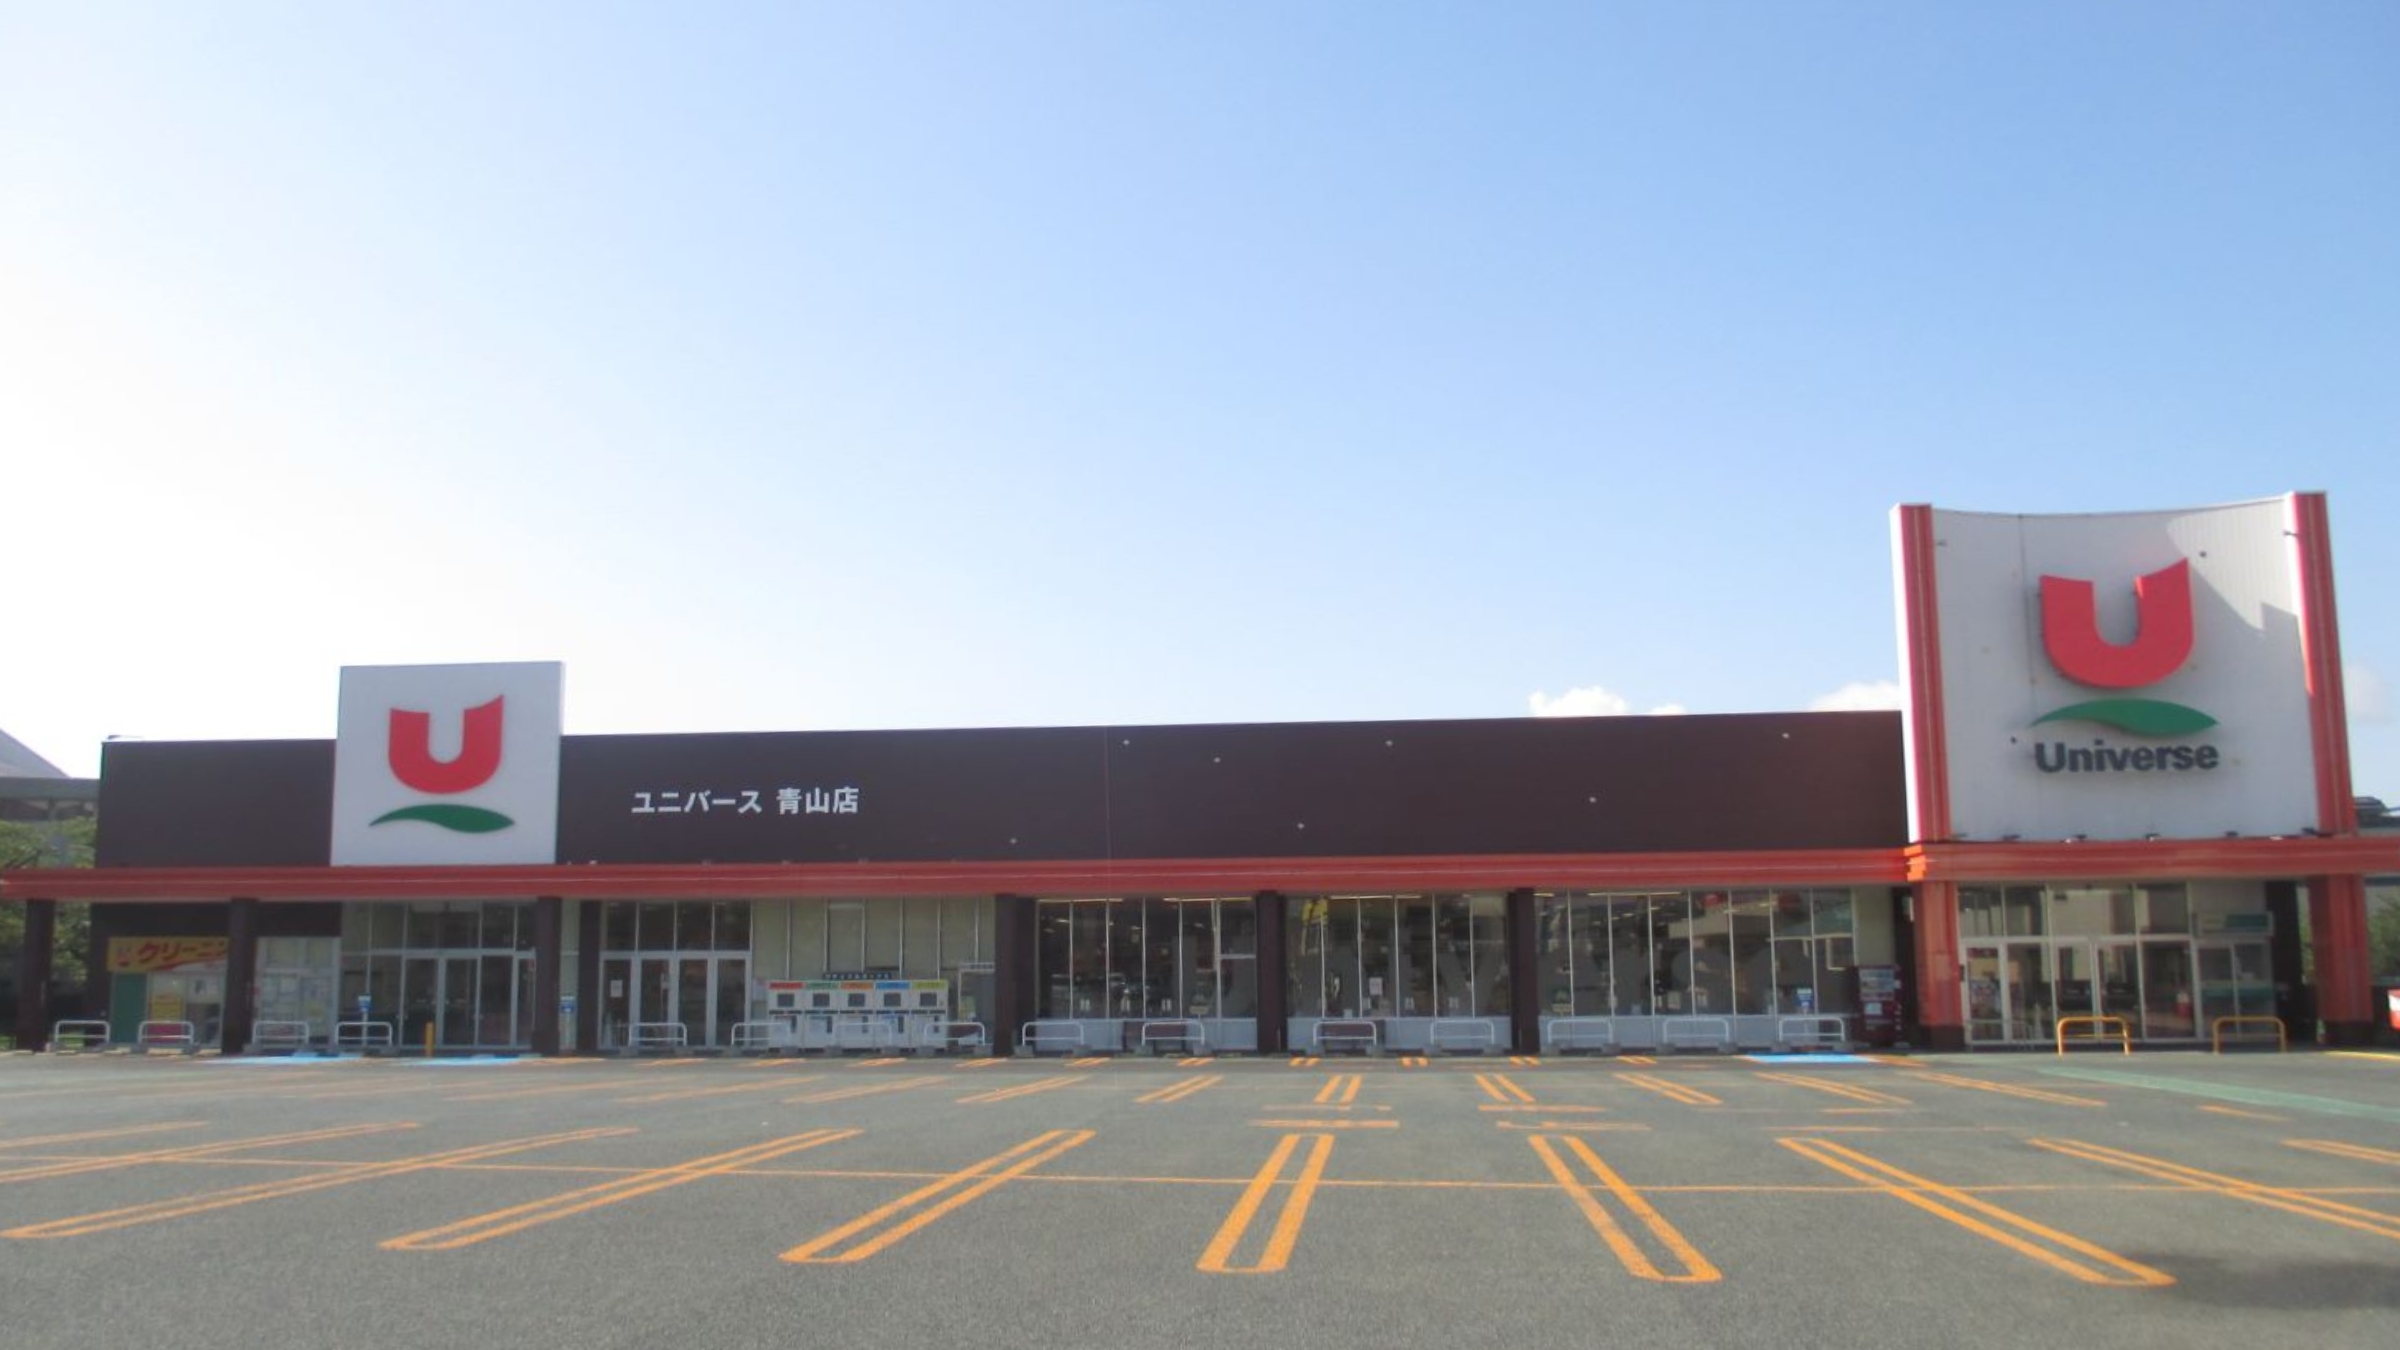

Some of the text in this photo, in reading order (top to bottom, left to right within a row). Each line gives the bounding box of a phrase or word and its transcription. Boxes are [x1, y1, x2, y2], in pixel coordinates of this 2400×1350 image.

[2039, 557, 2195, 689] U
[388, 694, 504, 794] U
[2034, 739, 2220, 774] Universe
[631, 786, 860, 815] ユニバース 青山店
